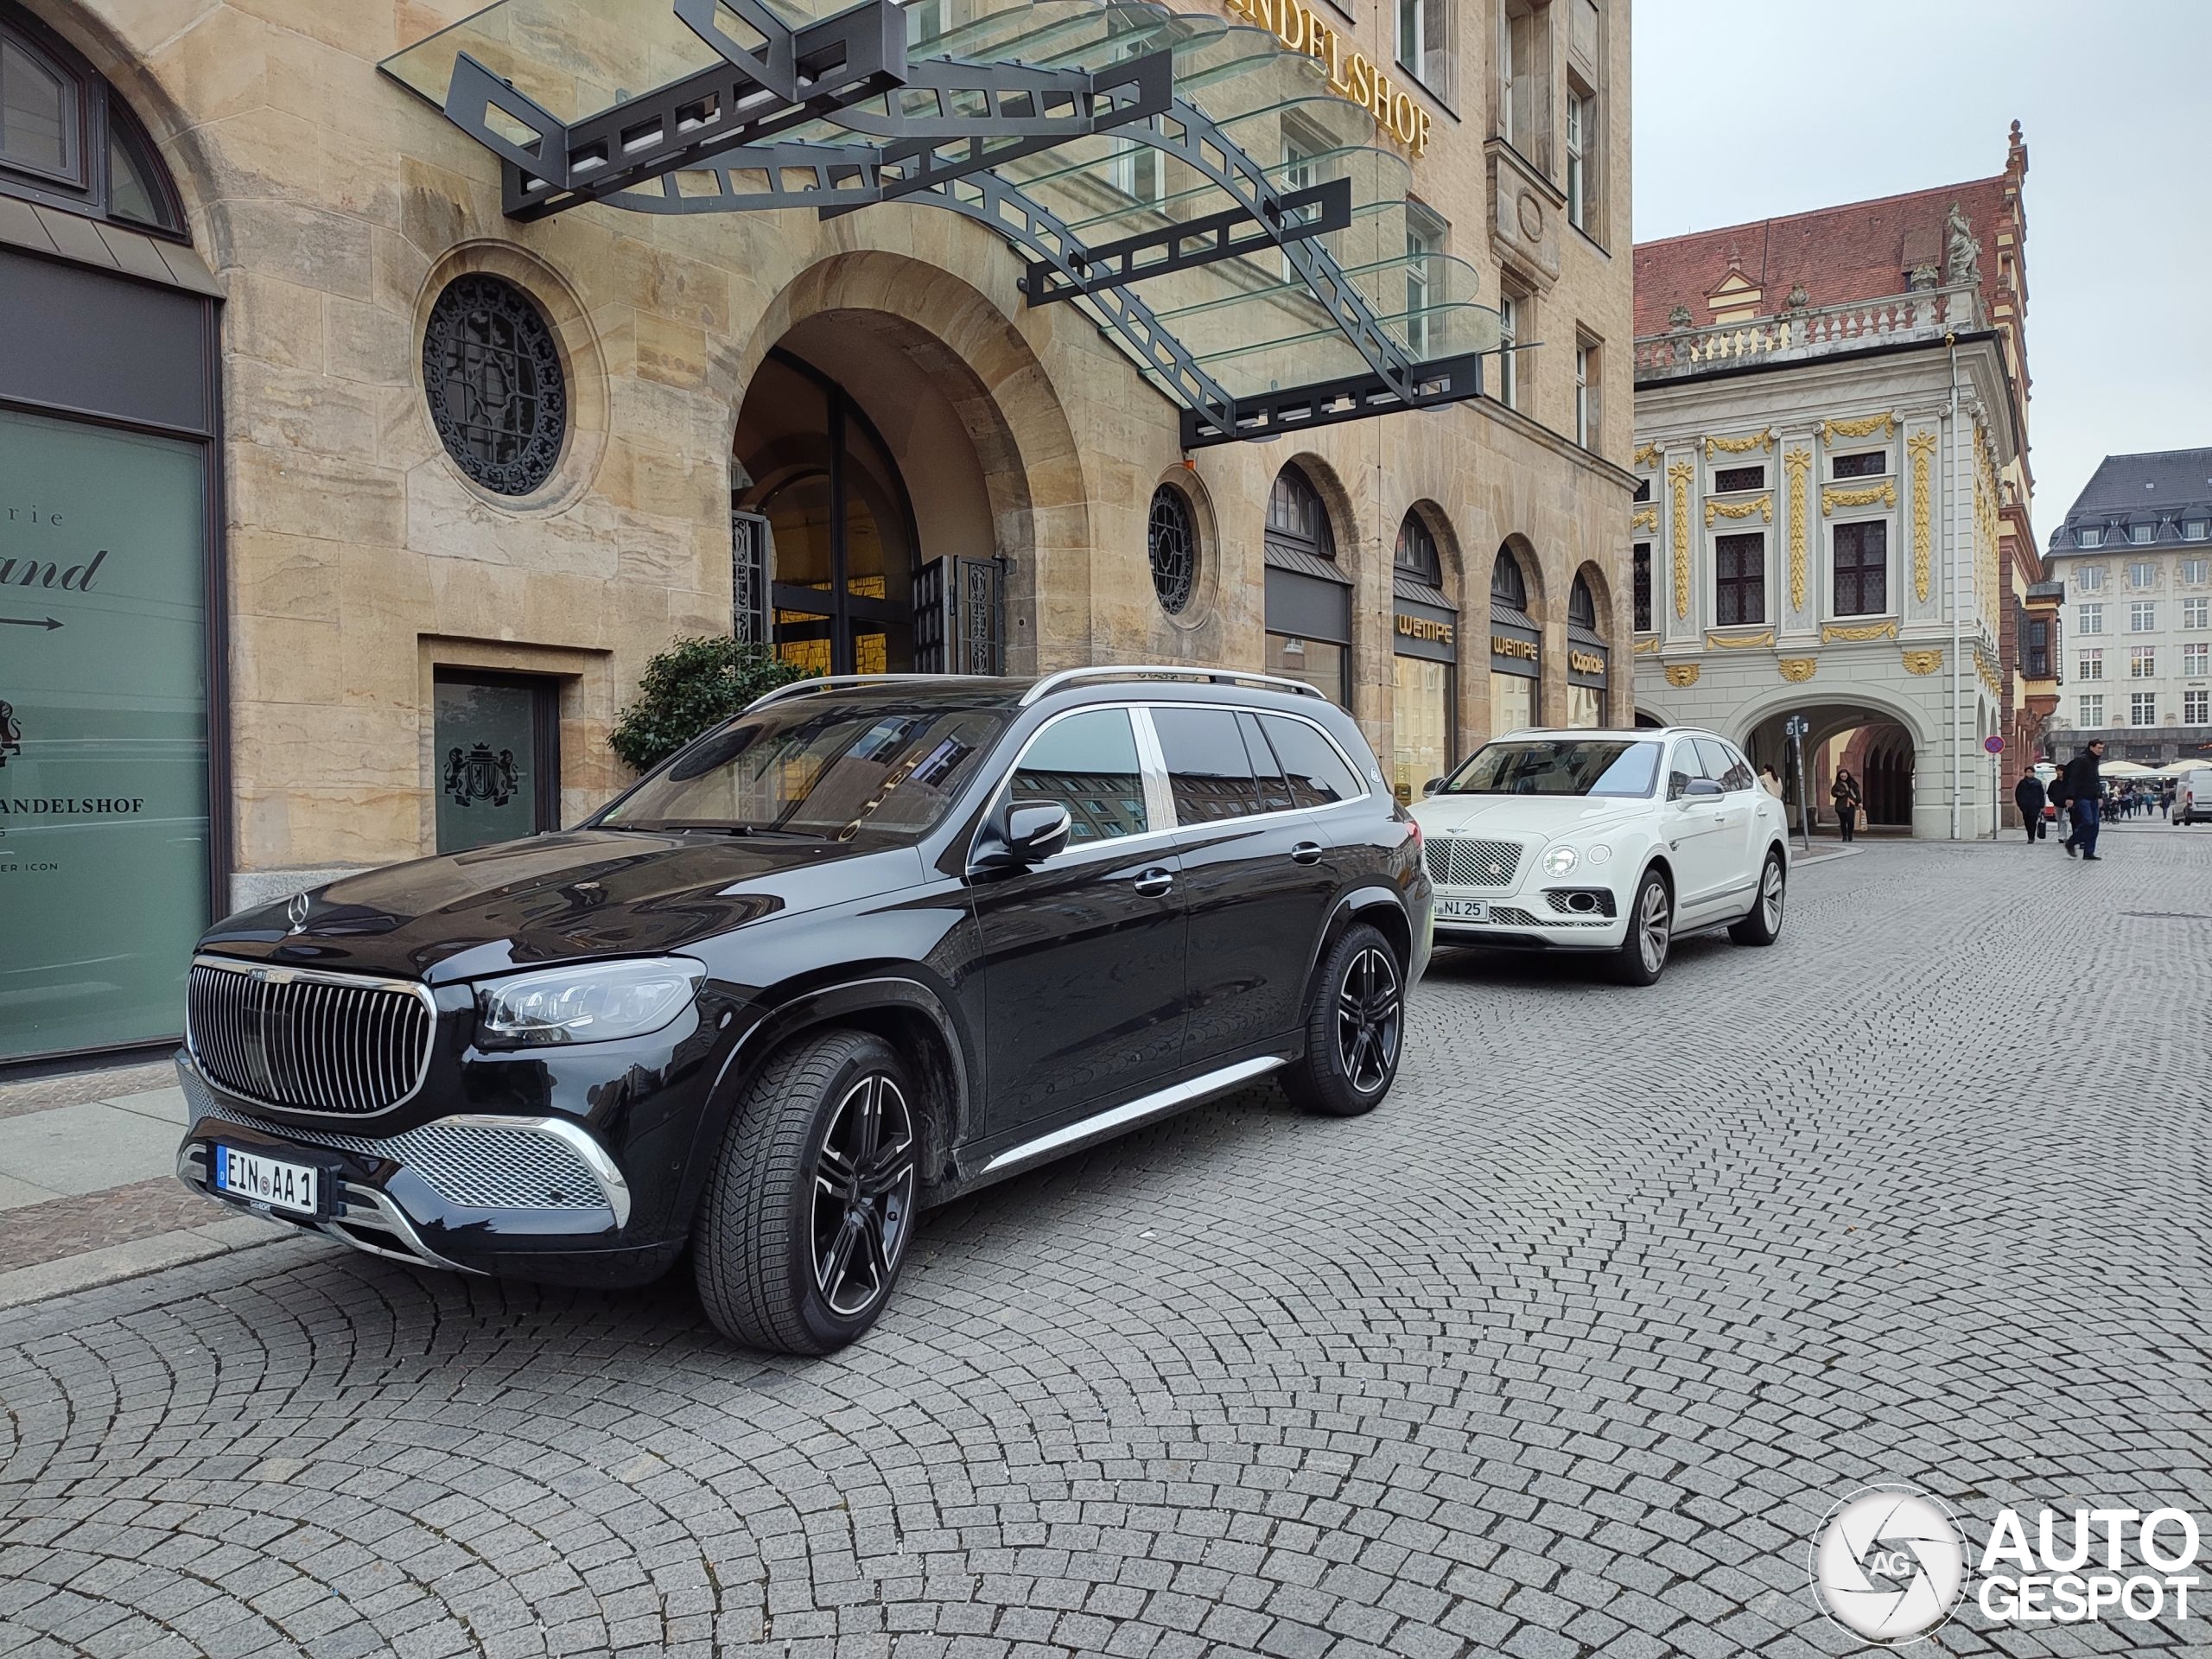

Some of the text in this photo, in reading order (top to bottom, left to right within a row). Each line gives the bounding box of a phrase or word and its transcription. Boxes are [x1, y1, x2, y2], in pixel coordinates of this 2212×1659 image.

[8, 505, 63, 526] rie
[1396, 614, 1453, 644] WEMPE
[1492, 635, 1538, 661] WEMPE
[25, 862, 58, 872] ICON
[1445, 901, 1460, 914] NI
[1465, 903, 1481, 916] 25
[228, 1153, 258, 1193] EIN
